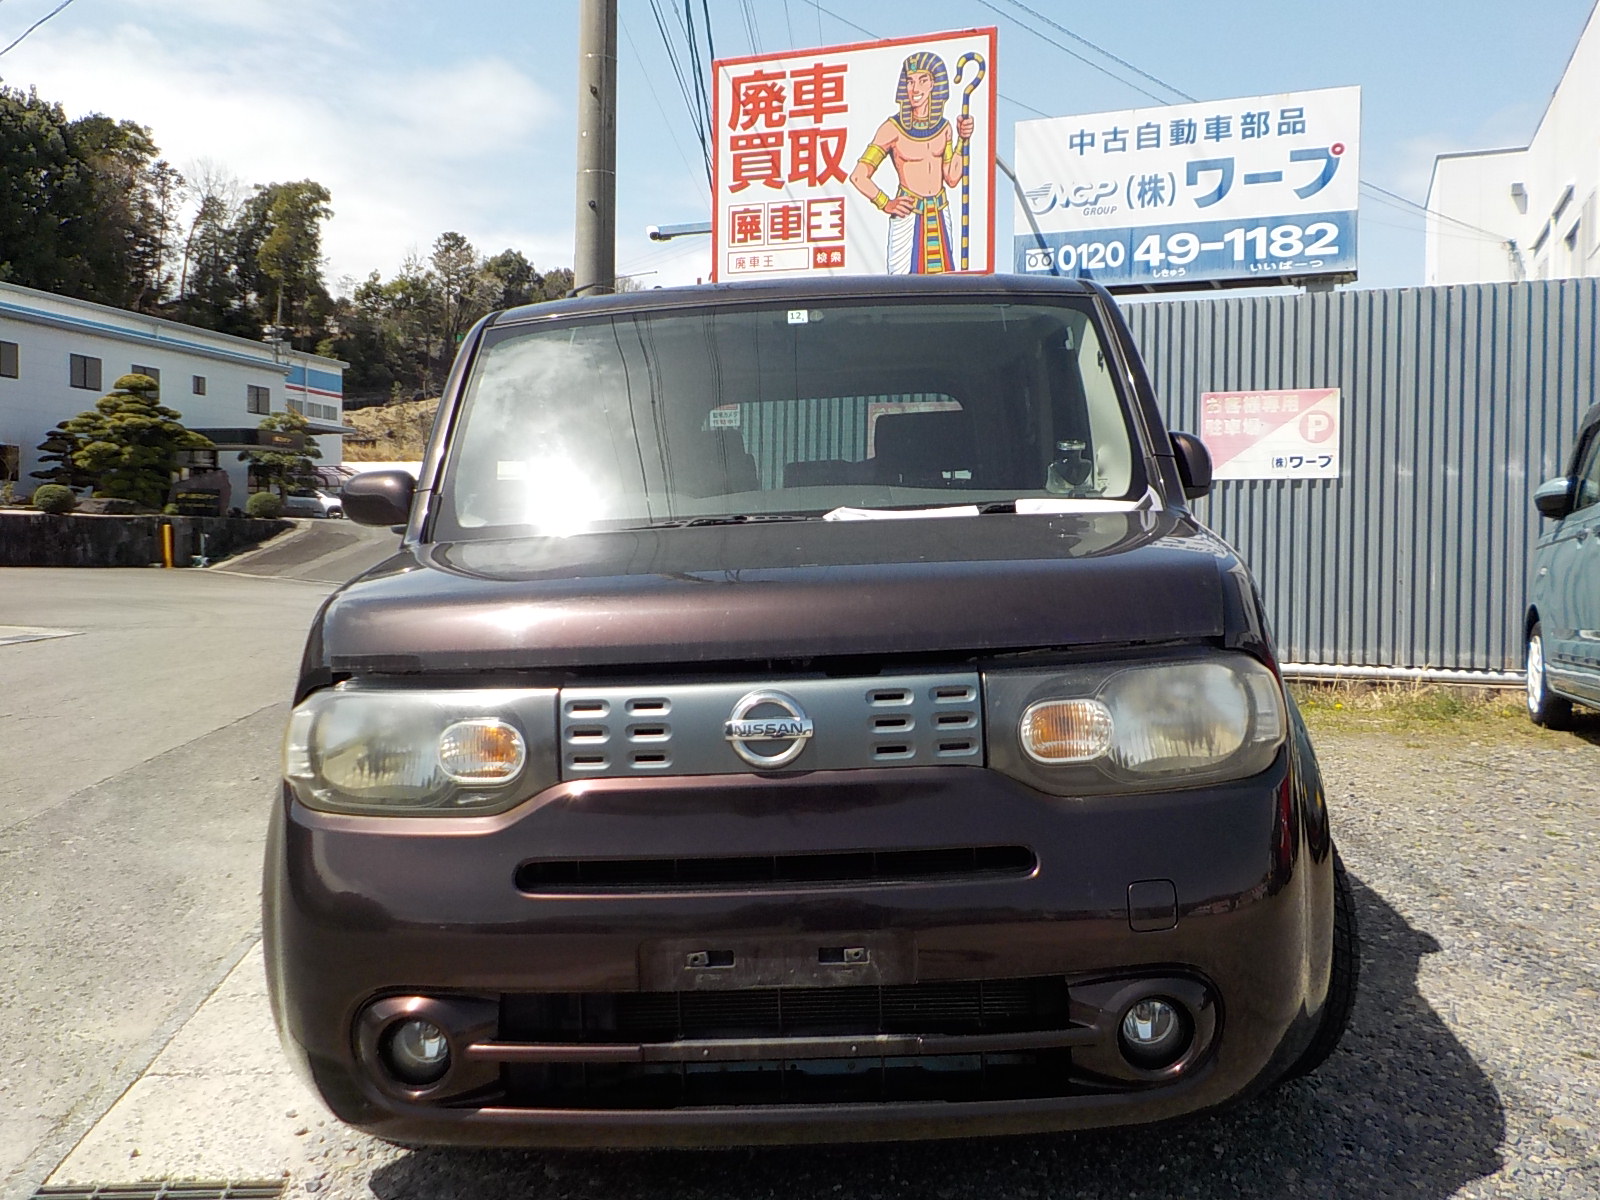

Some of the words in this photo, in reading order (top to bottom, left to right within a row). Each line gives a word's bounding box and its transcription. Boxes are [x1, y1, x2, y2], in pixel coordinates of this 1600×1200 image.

[728, 62, 848, 131] 廃車
[1069, 107, 1306, 156] 中古自動車部品
[728, 127, 849, 194] 買取
[1082, 205, 1118, 217] GROUP
[1058, 240, 1125, 271] 0120
[1133, 222, 1340, 267] 49-1182
[735, 255, 774, 270] 廃車王
[816, 251, 842, 264] 検索
[1152, 267, 1187, 279] しきゅう
[1308, 414, 1329, 440] P
[734, 722, 803, 736] NISSAN
